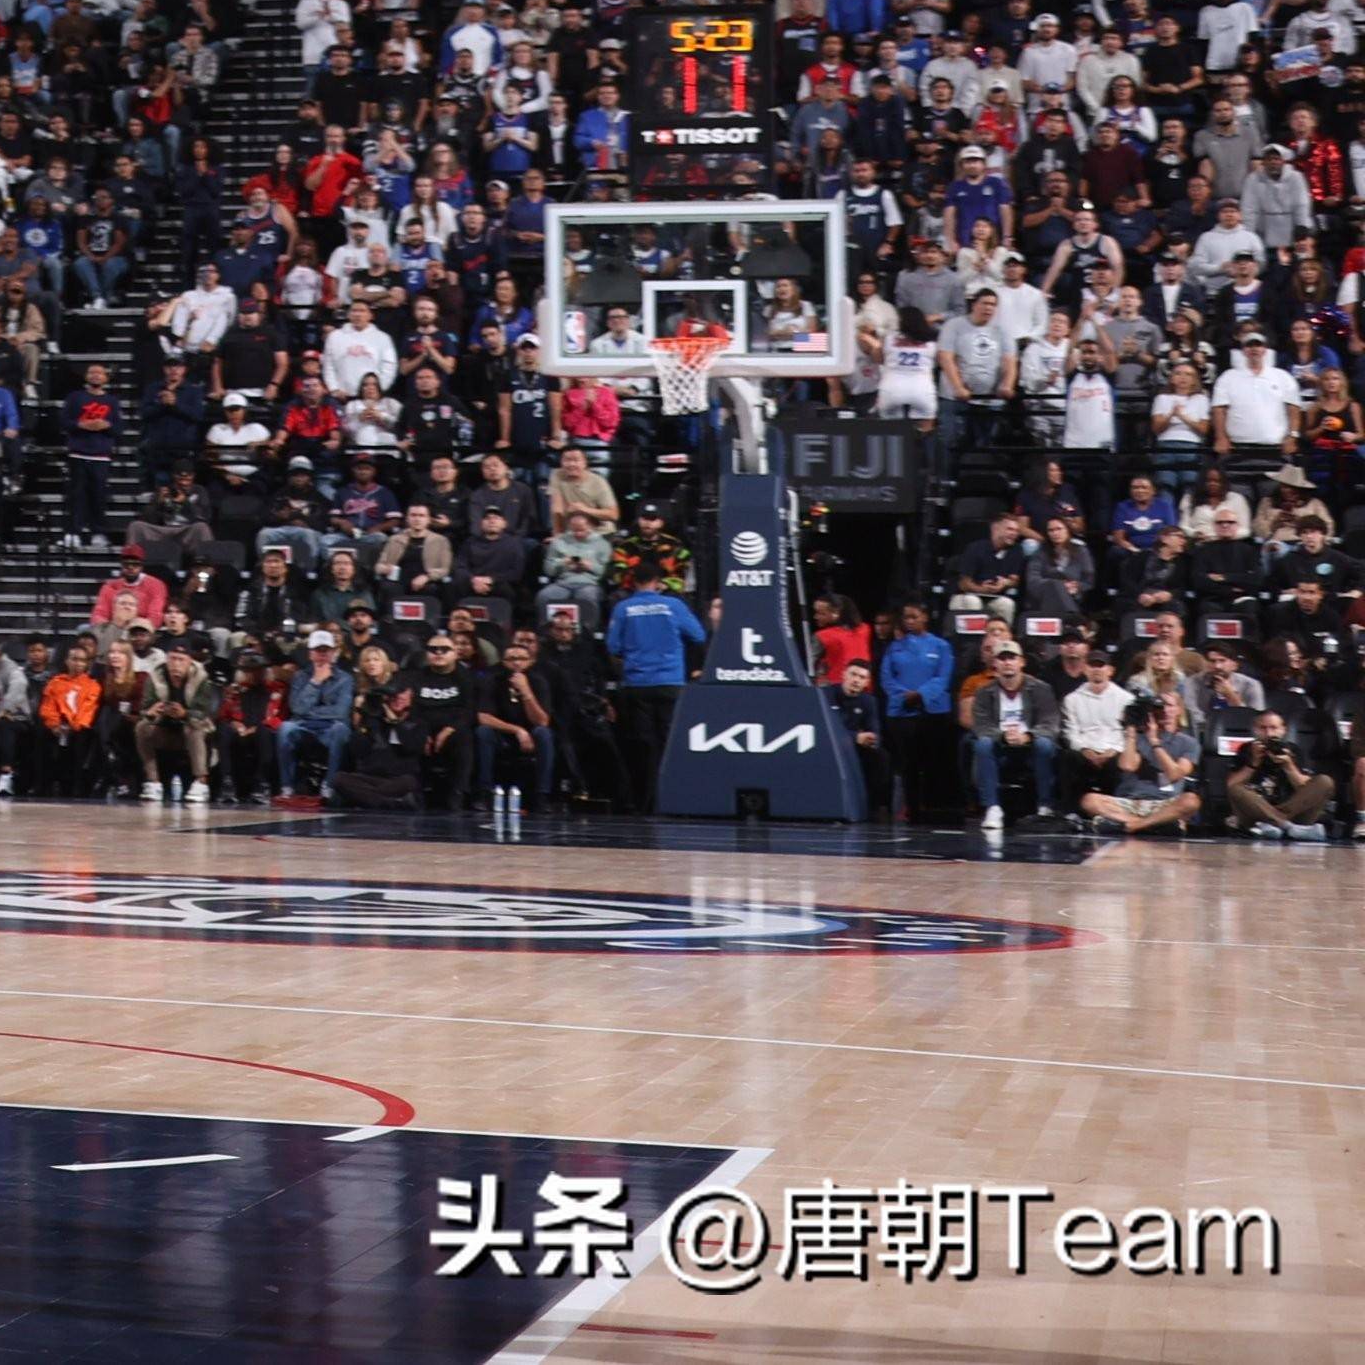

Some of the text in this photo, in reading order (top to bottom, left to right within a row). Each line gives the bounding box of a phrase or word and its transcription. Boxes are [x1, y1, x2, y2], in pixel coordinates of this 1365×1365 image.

[670, 20, 754, 52] 5:23
[682, 55, 747, 115] 11
[673, 128, 762, 144] TISSOT
[899, 352, 920, 366] 22
[793, 434, 904, 479] FIJI
[725, 570, 775, 586] AT&T
[421, 687, 459, 700] BOSS
[689, 723, 815, 753] KIA
